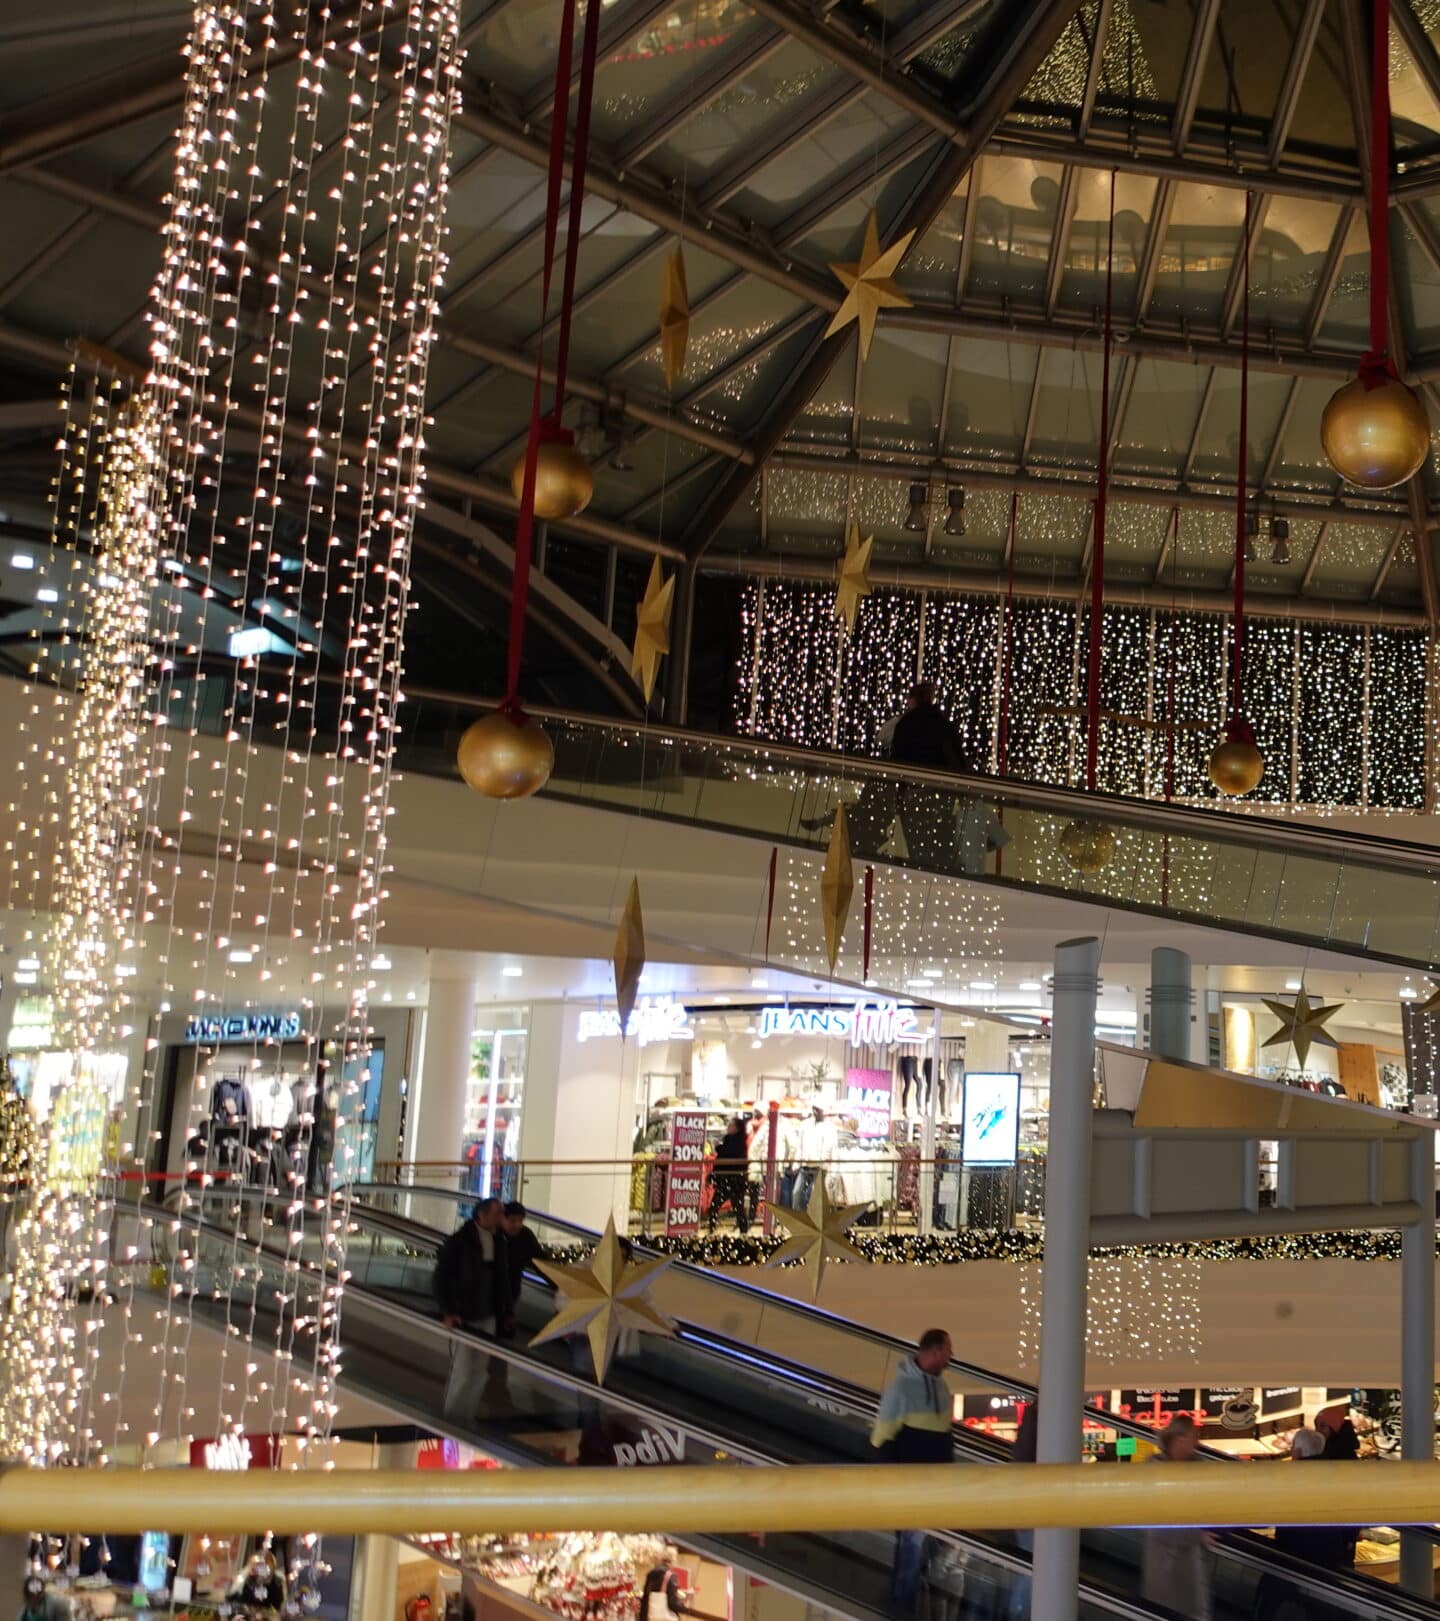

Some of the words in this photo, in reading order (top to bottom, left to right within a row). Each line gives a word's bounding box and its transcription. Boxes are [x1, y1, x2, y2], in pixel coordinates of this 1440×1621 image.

[758, 1008, 851, 1037] JEANS
[676, 1116, 704, 1129] BLACK
[674, 1145, 702, 1160] 30%
[671, 1178, 700, 1191] BLACK
[669, 1207, 698, 1225] 30%
